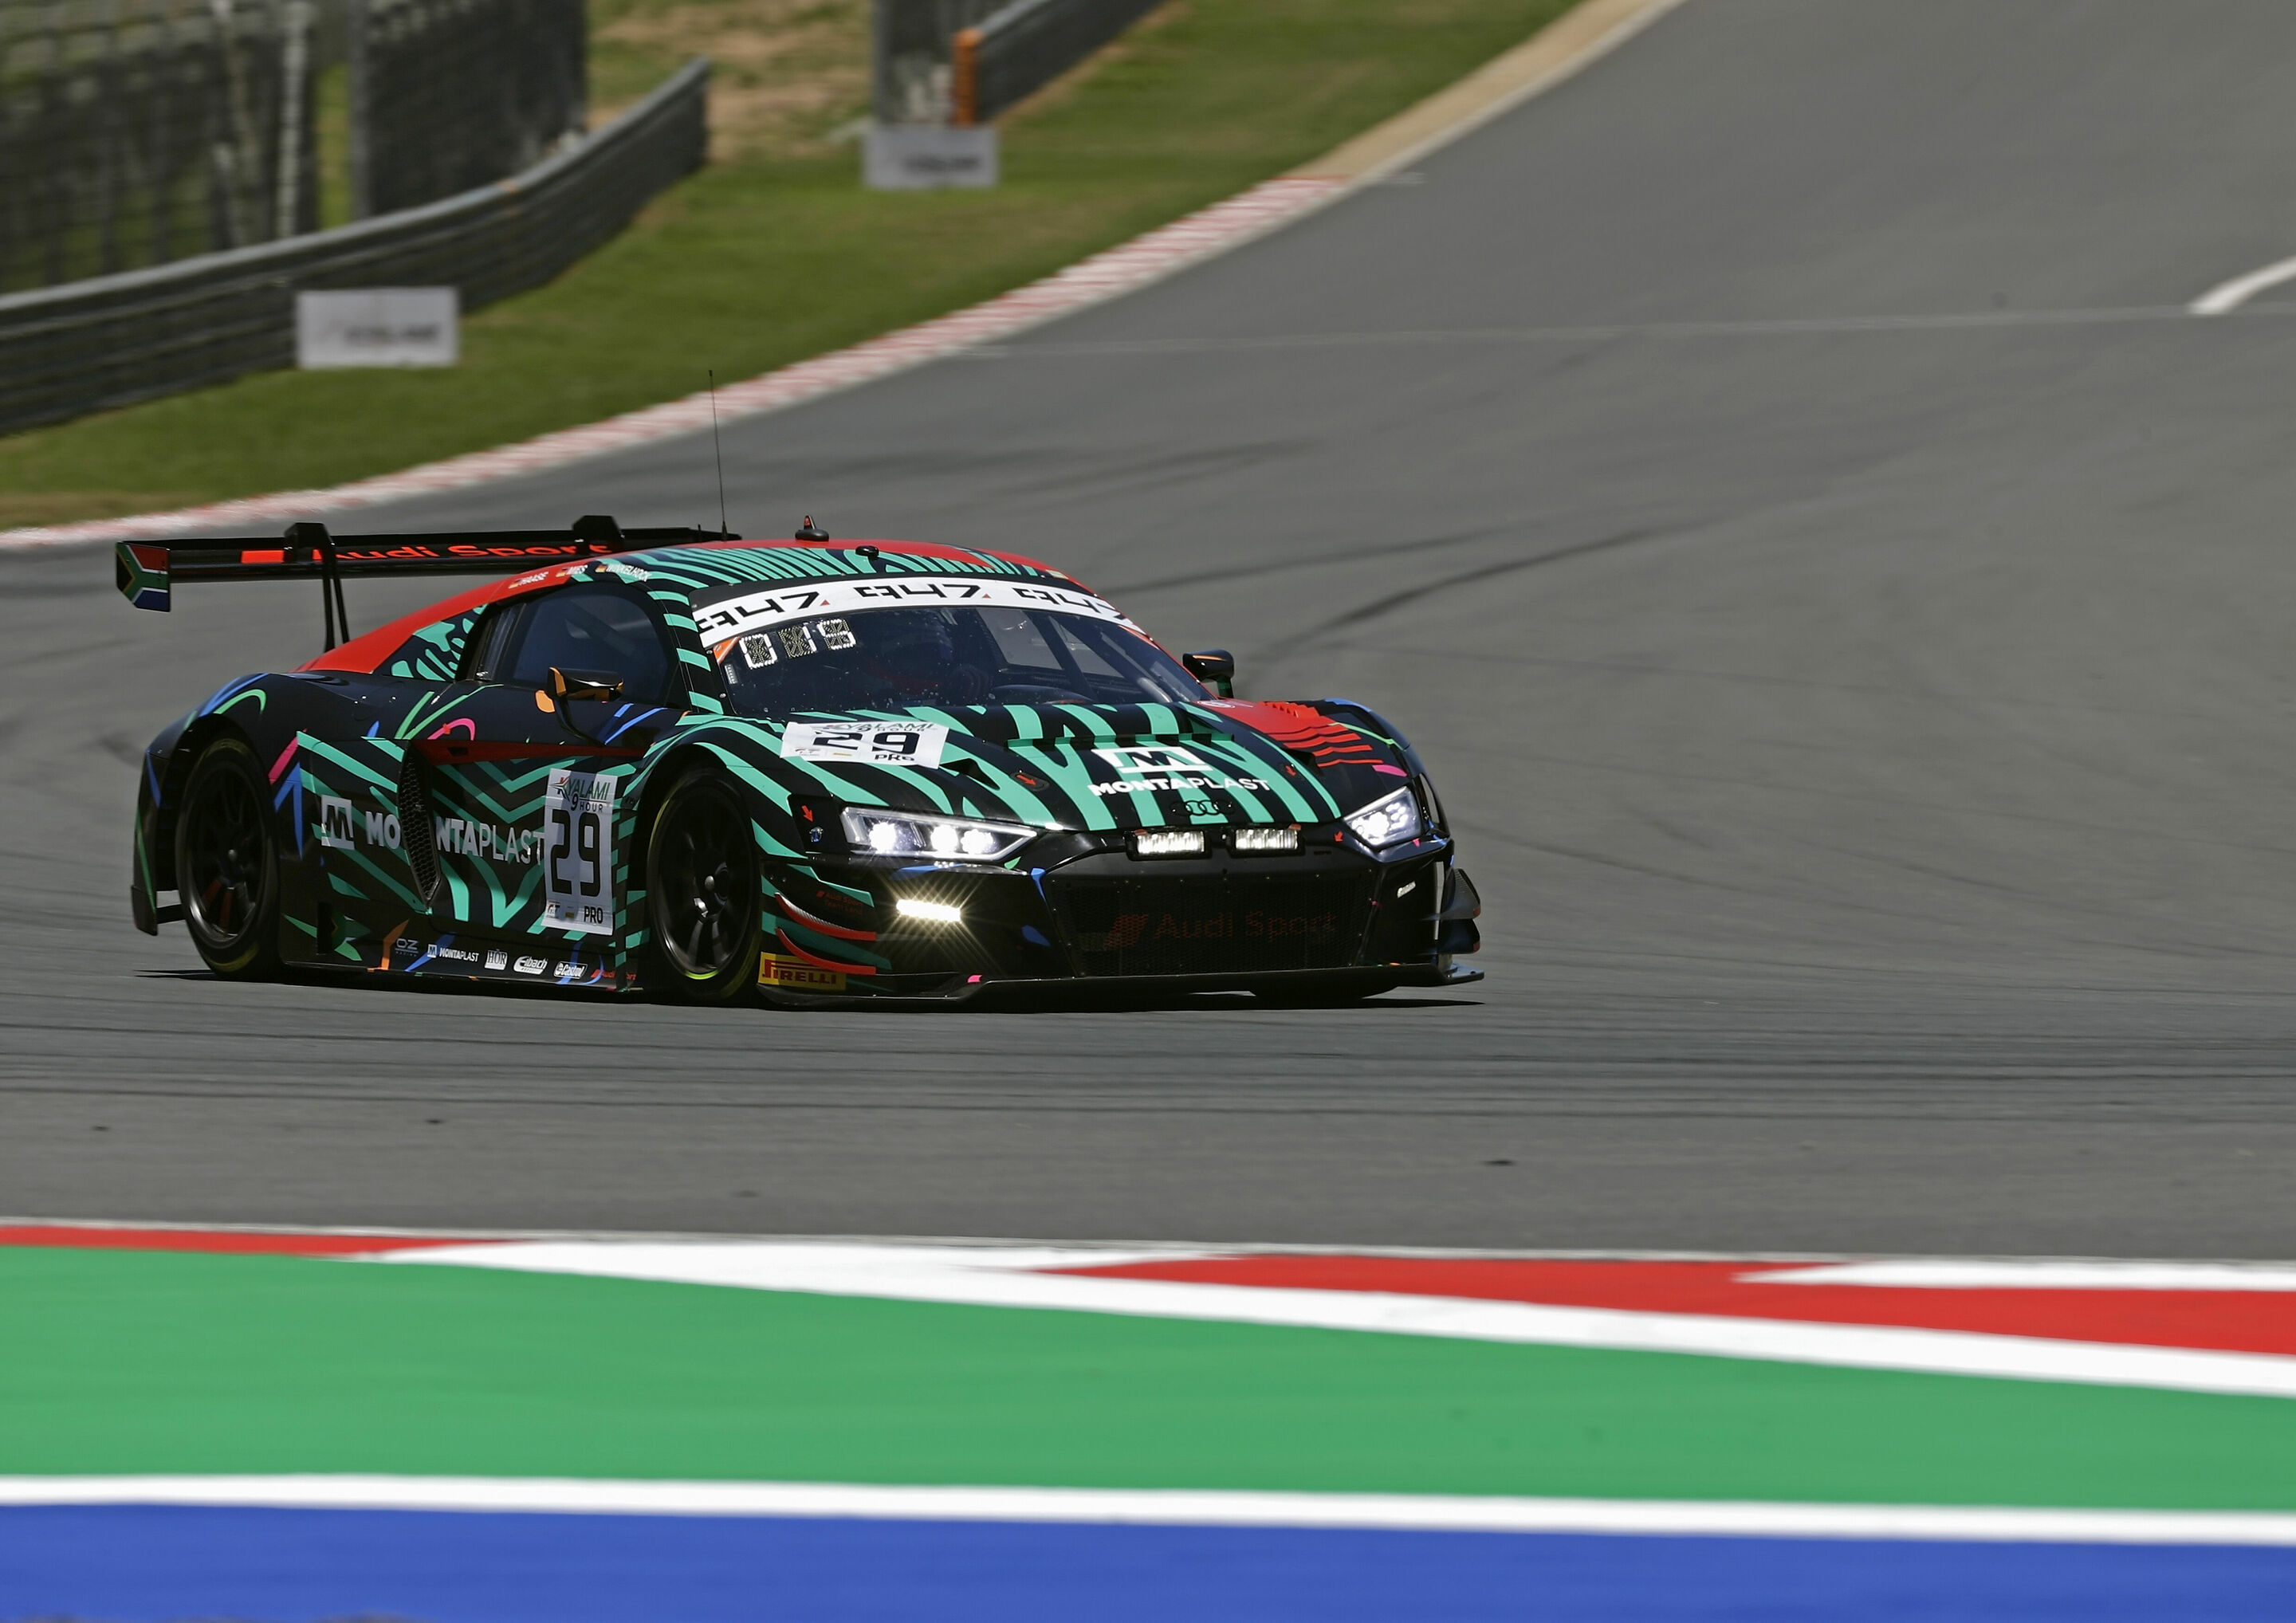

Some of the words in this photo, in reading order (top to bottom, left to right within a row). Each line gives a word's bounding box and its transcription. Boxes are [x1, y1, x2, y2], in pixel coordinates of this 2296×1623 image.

[853, 584, 980, 599] 947
[812, 732, 921, 755] 29
[1087, 778, 1271, 796] MONTAPLAST
[580, 801, 604, 813] HOUR
[550, 809, 600, 898] 29
[584, 906, 603, 924] PRO
[1154, 913, 1233, 939] Audi
[1245, 910, 1337, 943] Sport
[439, 948, 480, 962] MONTAPLAST
[762, 959, 837, 985] PIRELLI
